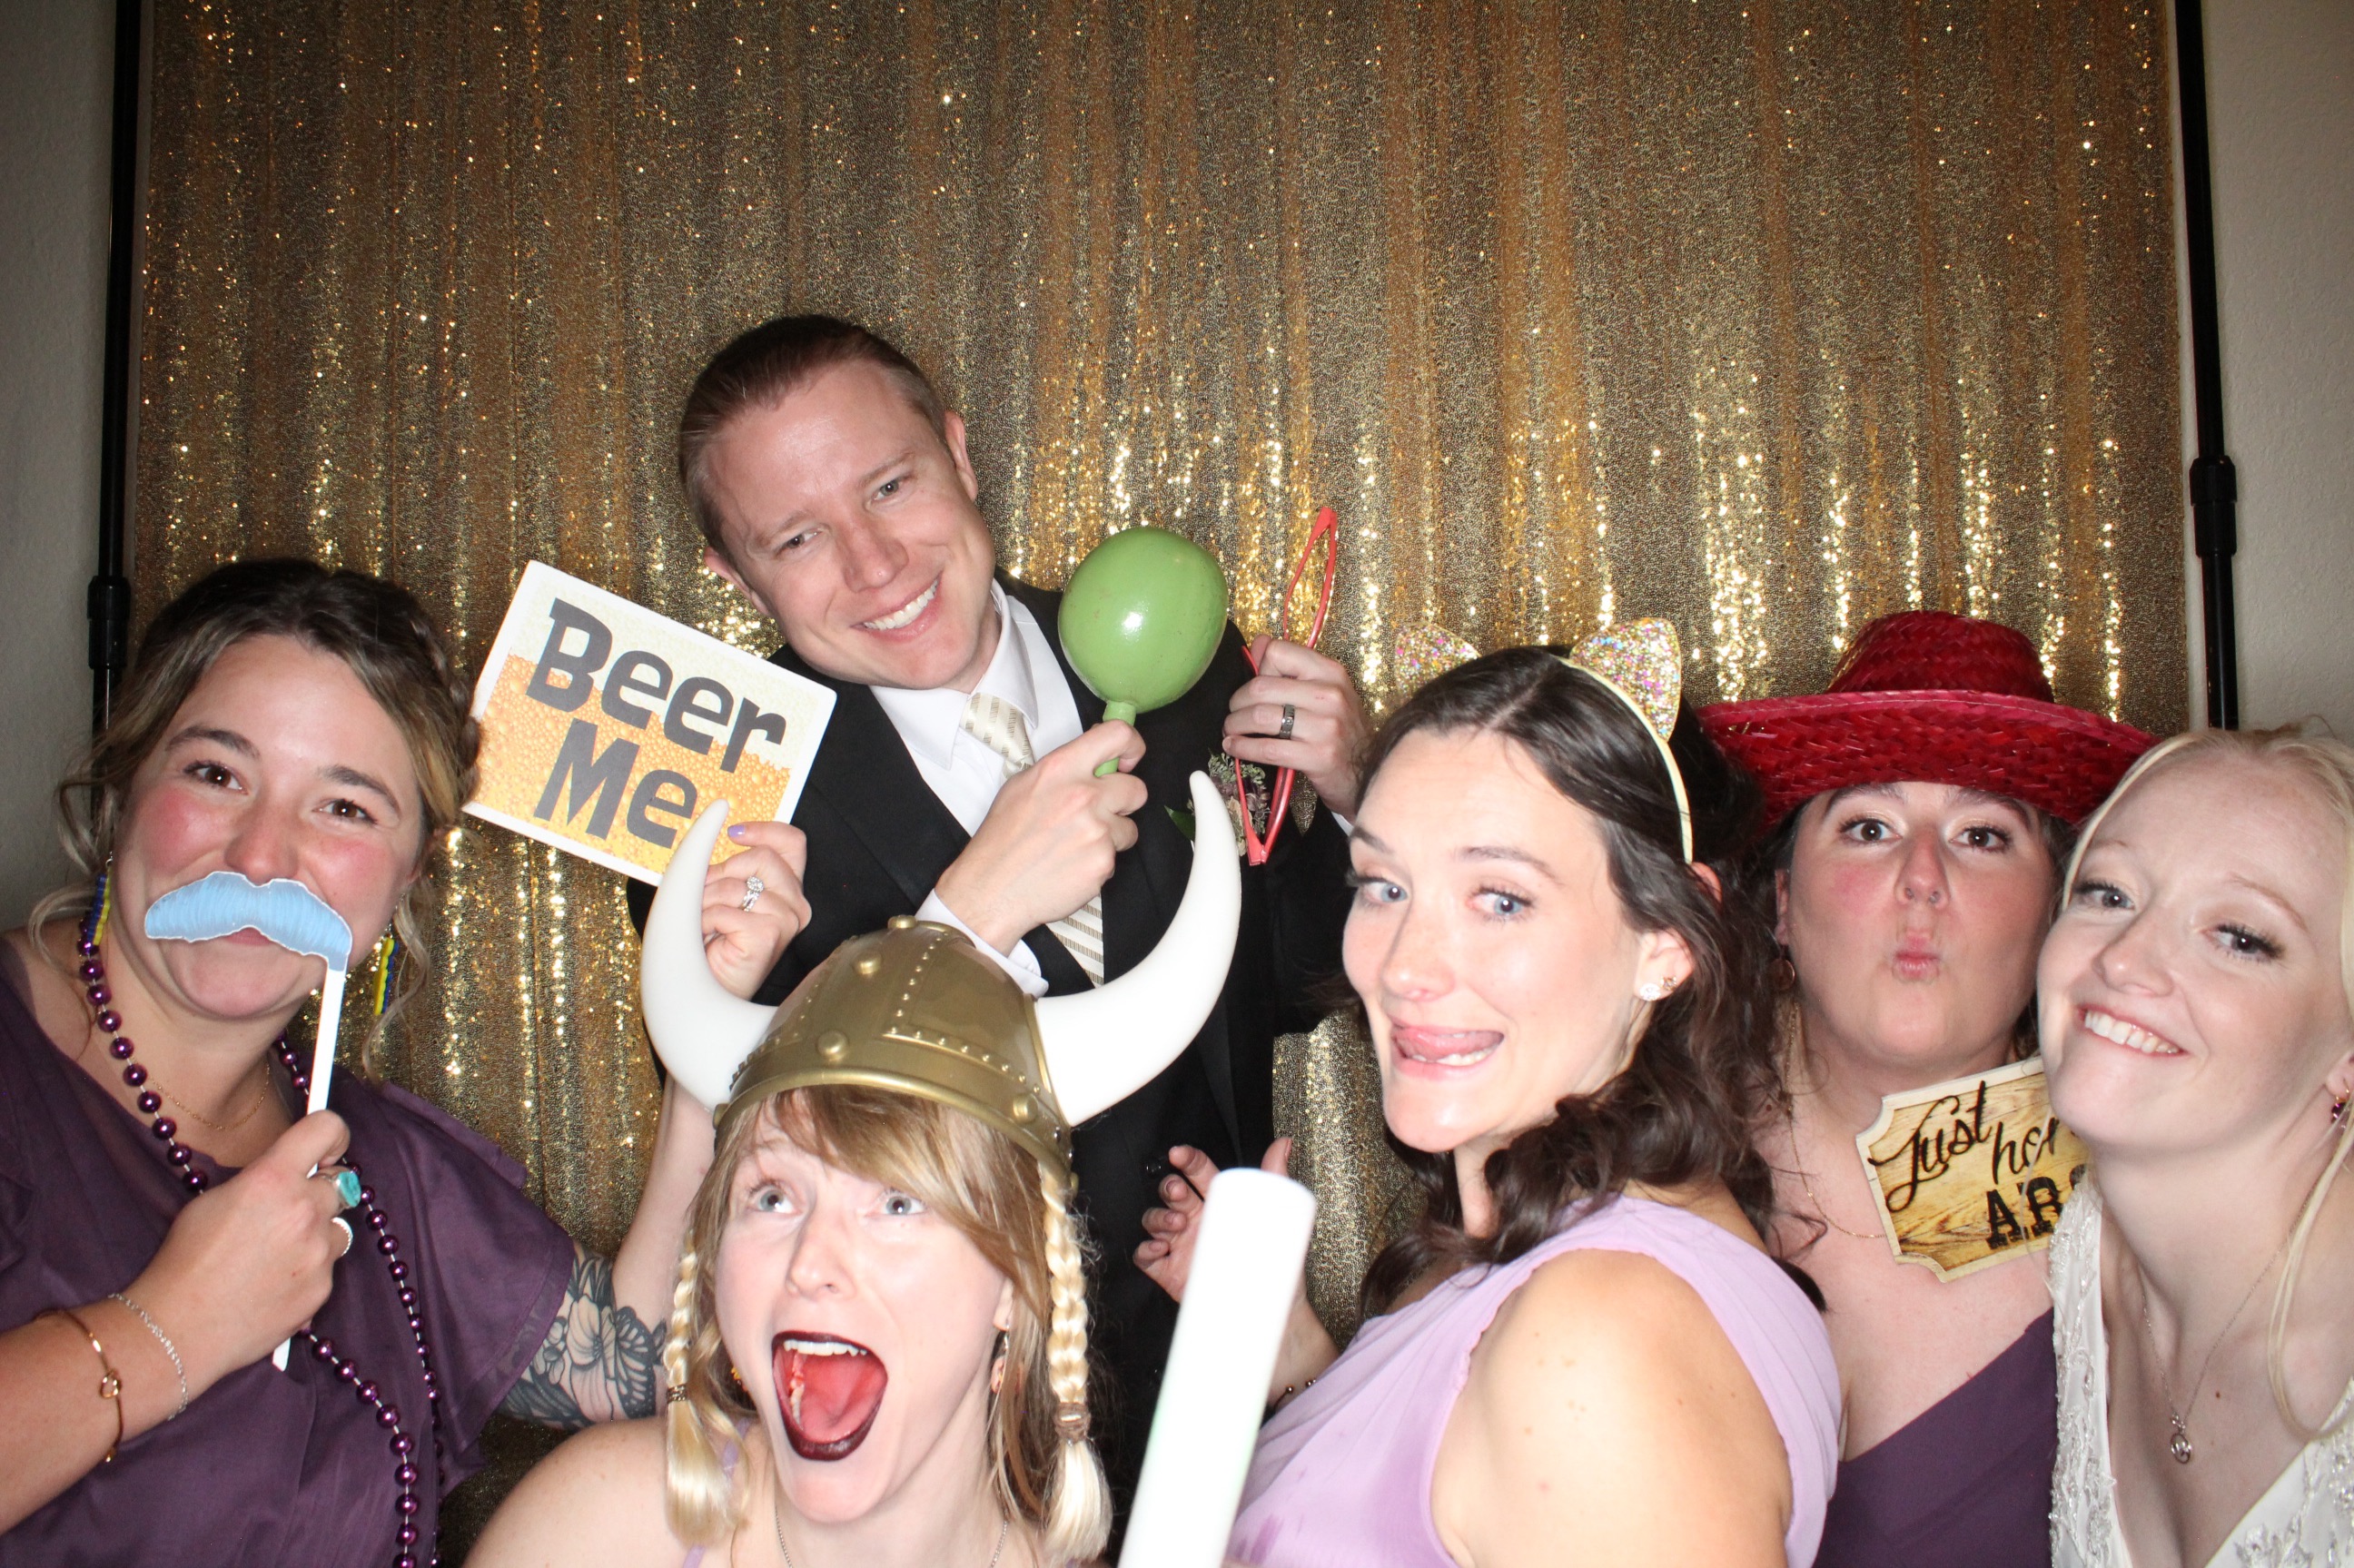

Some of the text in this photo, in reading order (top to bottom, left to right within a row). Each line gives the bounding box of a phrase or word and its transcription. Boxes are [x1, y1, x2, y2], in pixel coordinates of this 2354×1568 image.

[526, 597, 787, 774] Beer
[533, 717, 698, 850] Me
[1867, 1080, 1993, 1213] Just
